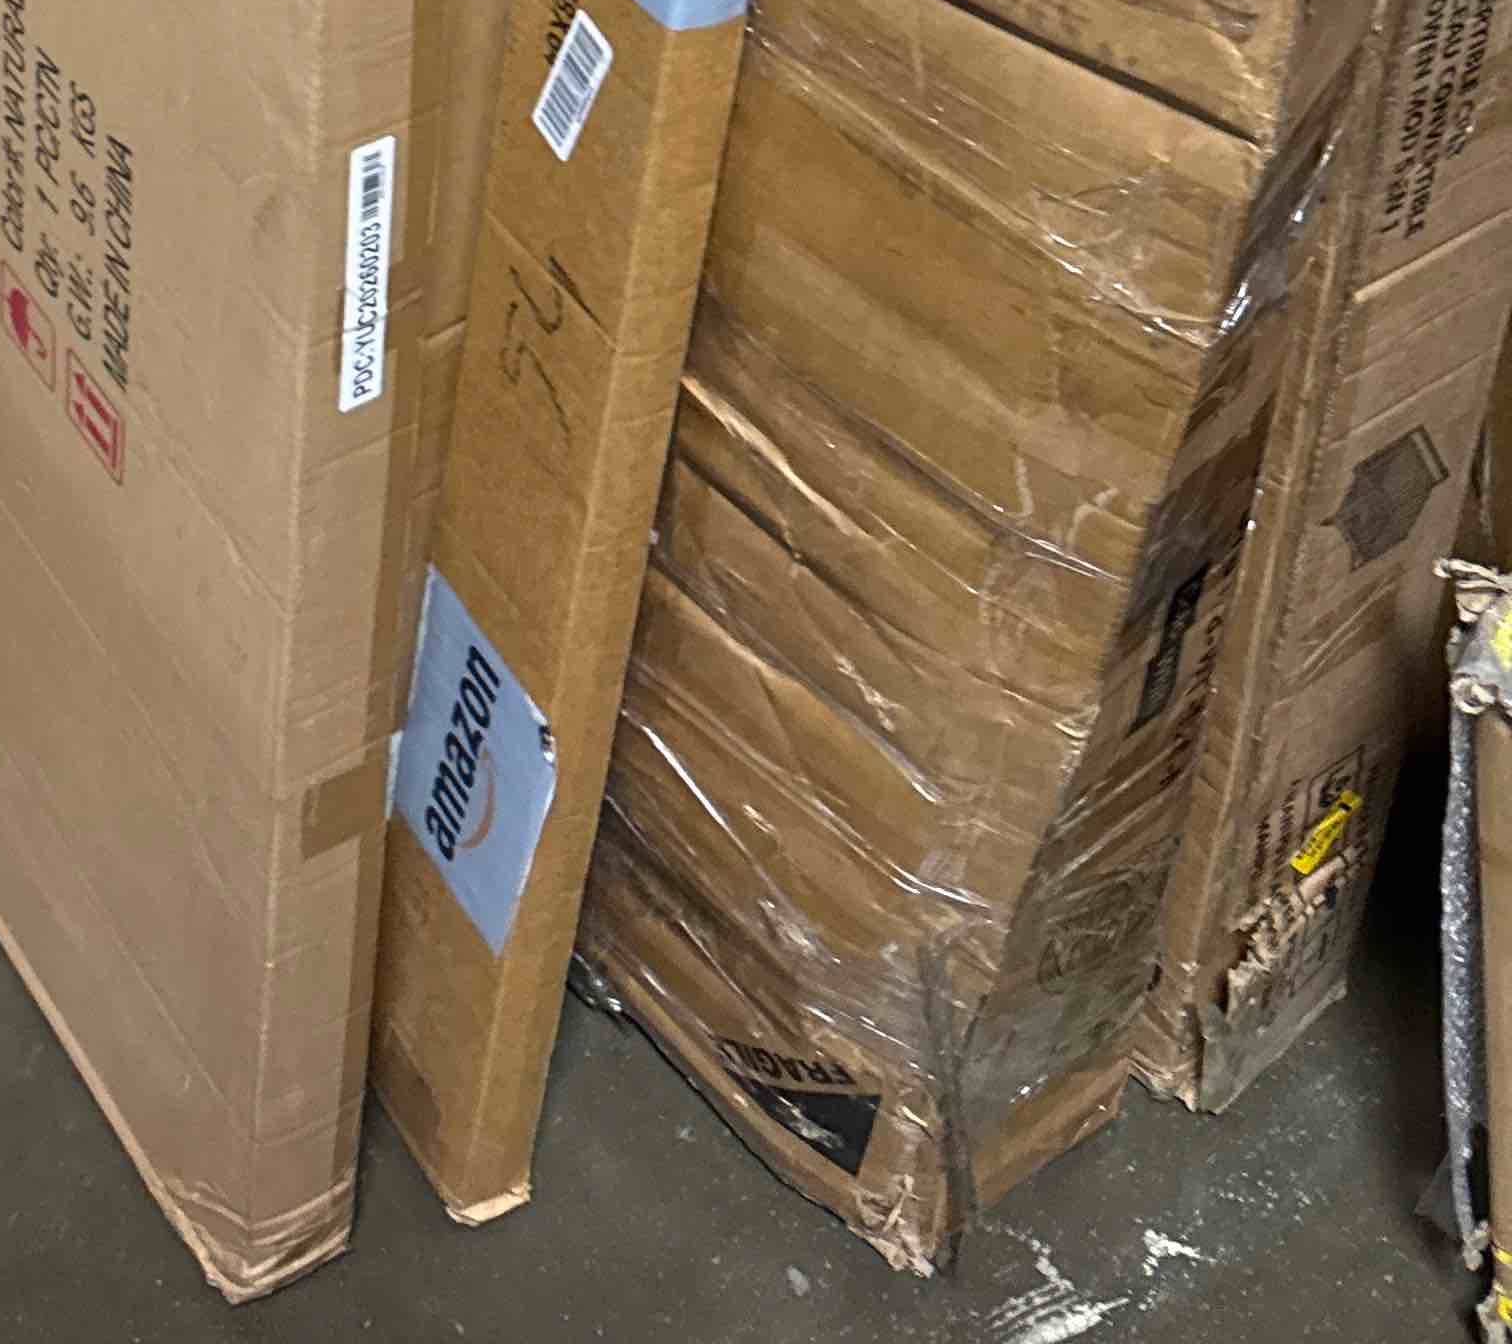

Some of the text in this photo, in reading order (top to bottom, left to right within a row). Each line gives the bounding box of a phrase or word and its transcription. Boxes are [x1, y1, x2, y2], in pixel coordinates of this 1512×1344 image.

[35, 189, 57, 222] 1
[102, 132, 130, 398] MADE IN CHINA
[424, 645, 501, 862] amazon
